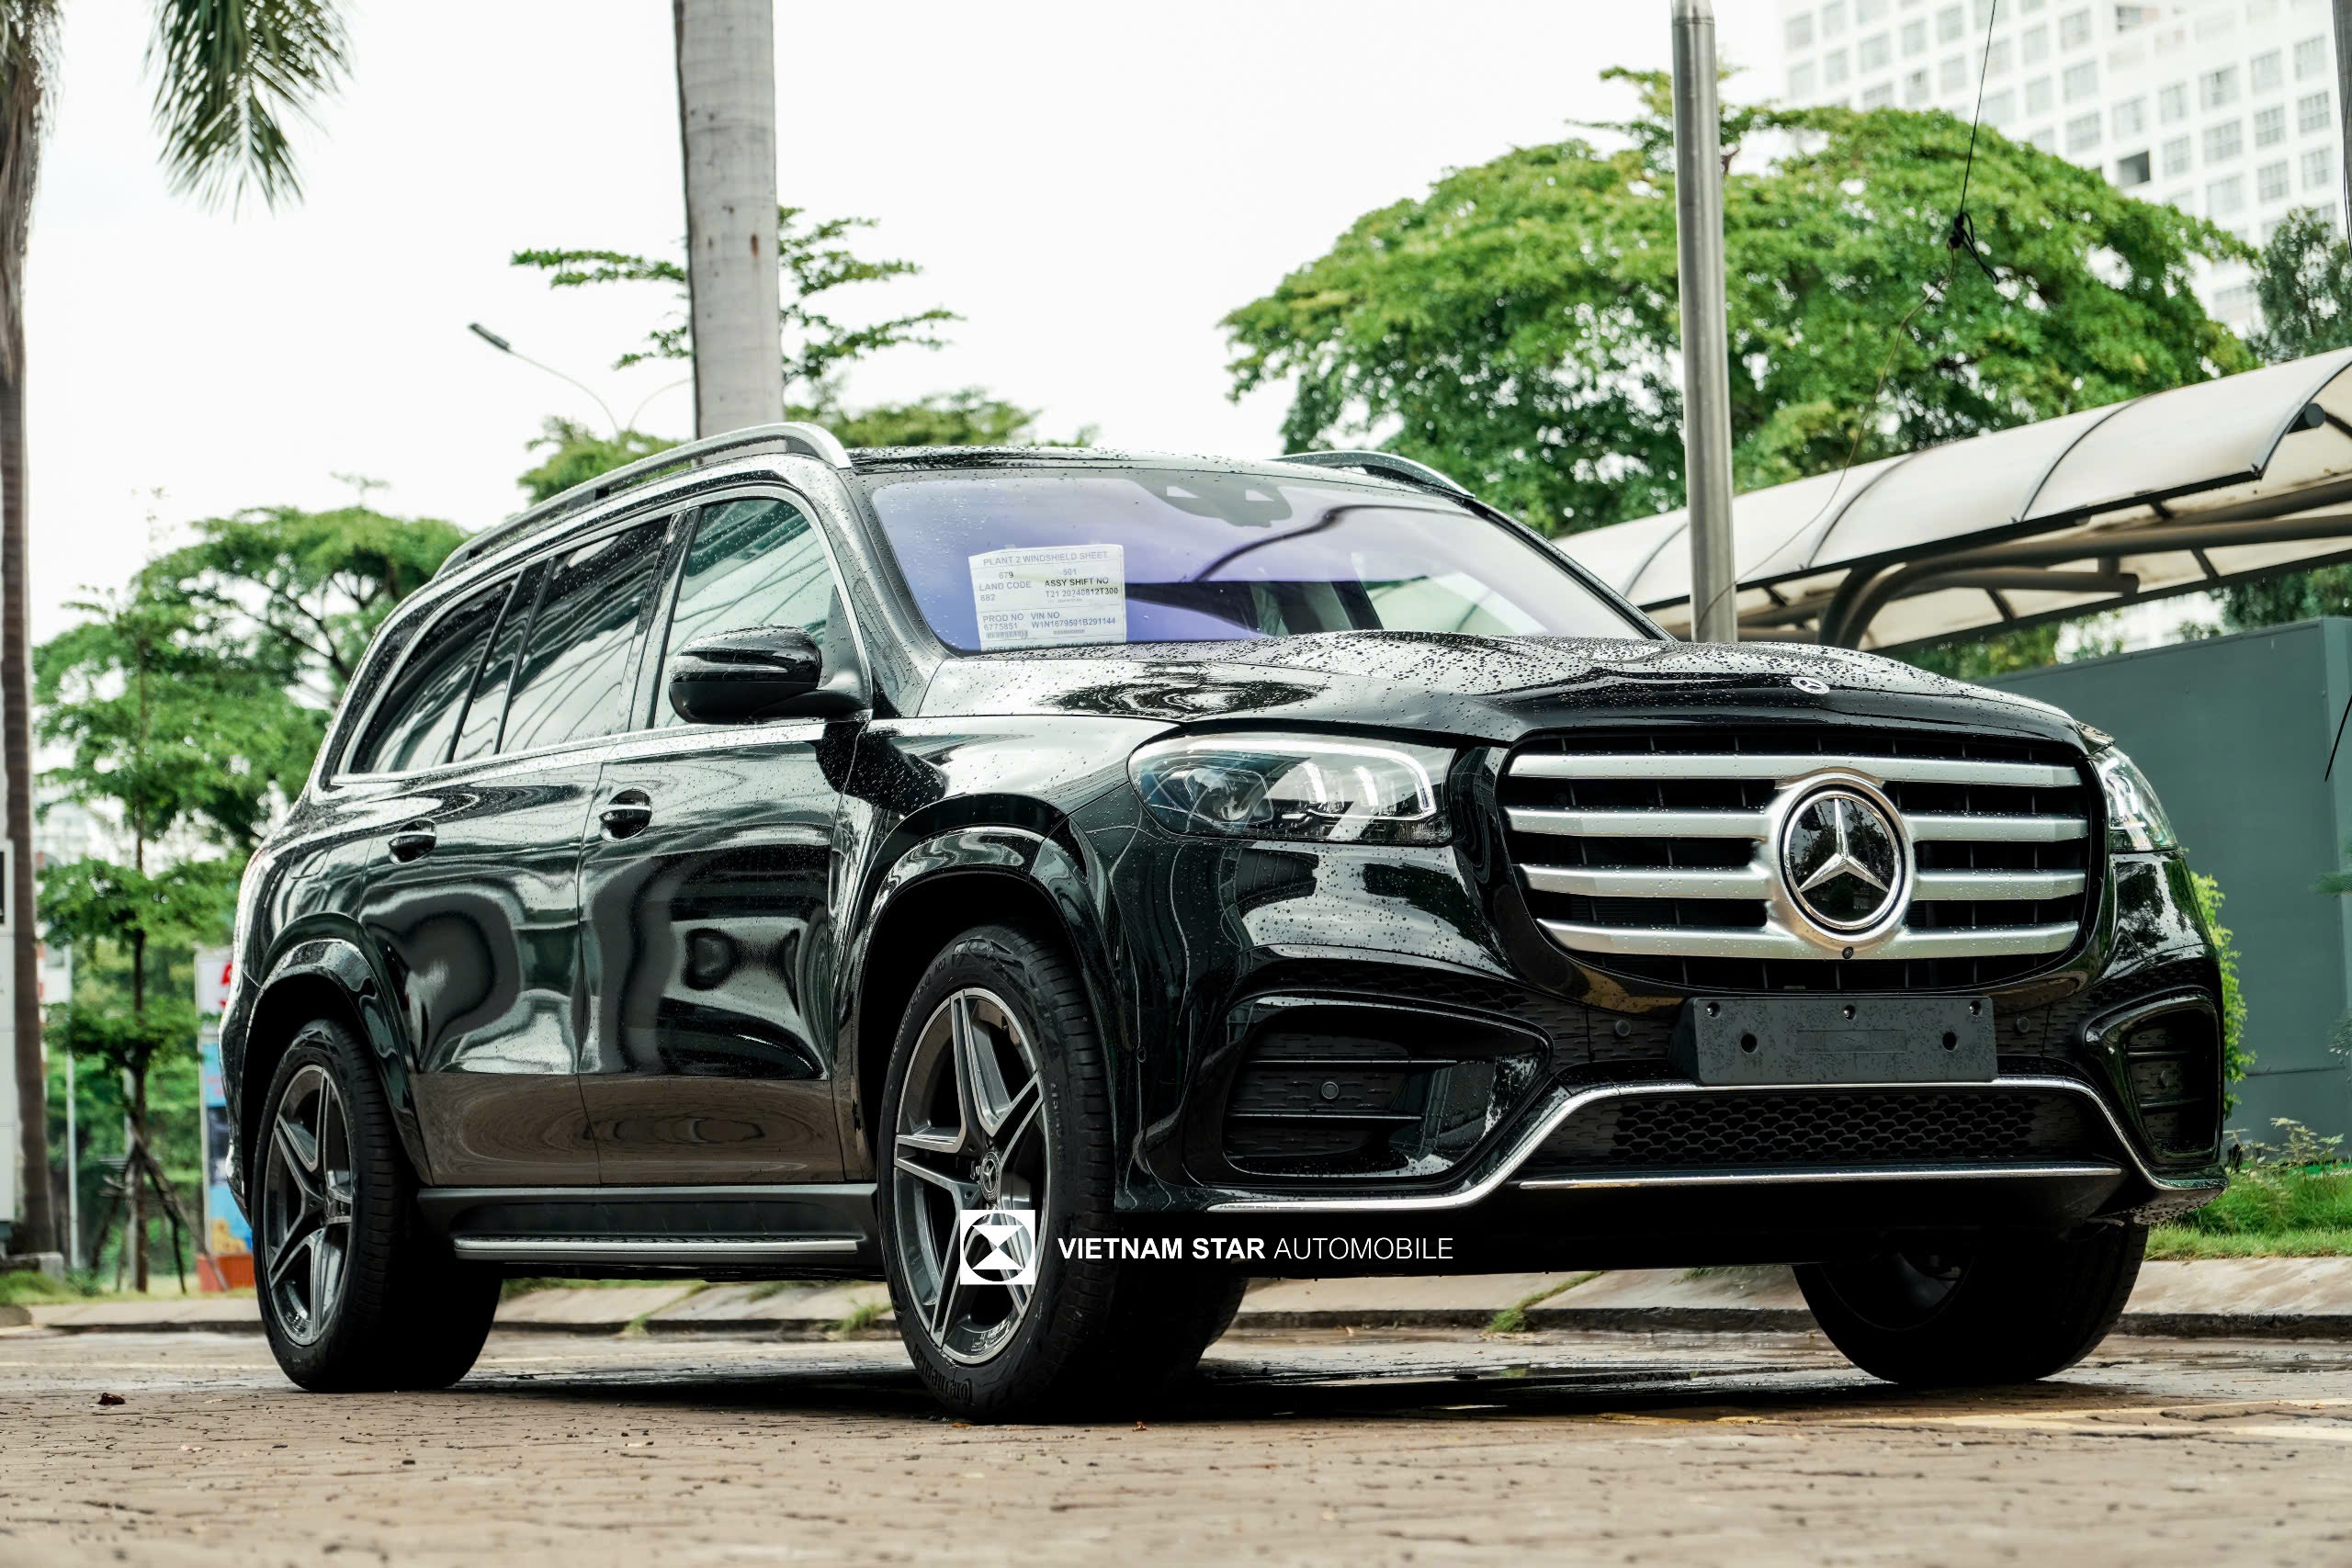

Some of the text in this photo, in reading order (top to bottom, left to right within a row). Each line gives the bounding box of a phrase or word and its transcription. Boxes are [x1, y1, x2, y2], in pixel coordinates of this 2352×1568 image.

[983, 556, 1013, 567] PLANT
[1023, 553, 1077, 563] WINDSHIELD
[1080, 551, 1108, 559] SHEET
[999, 571, 1014, 580] 679
[1063, 568, 1077, 576] 501
[979, 581, 1032, 592] LAND CODE
[1069, 578, 1093, 586] SHIFT
[980, 593, 996, 602] 882
[1045, 590, 1059, 598] T21
[983, 613, 1024, 623] PROD NO
[1030, 611, 1060, 620] VIN NO
